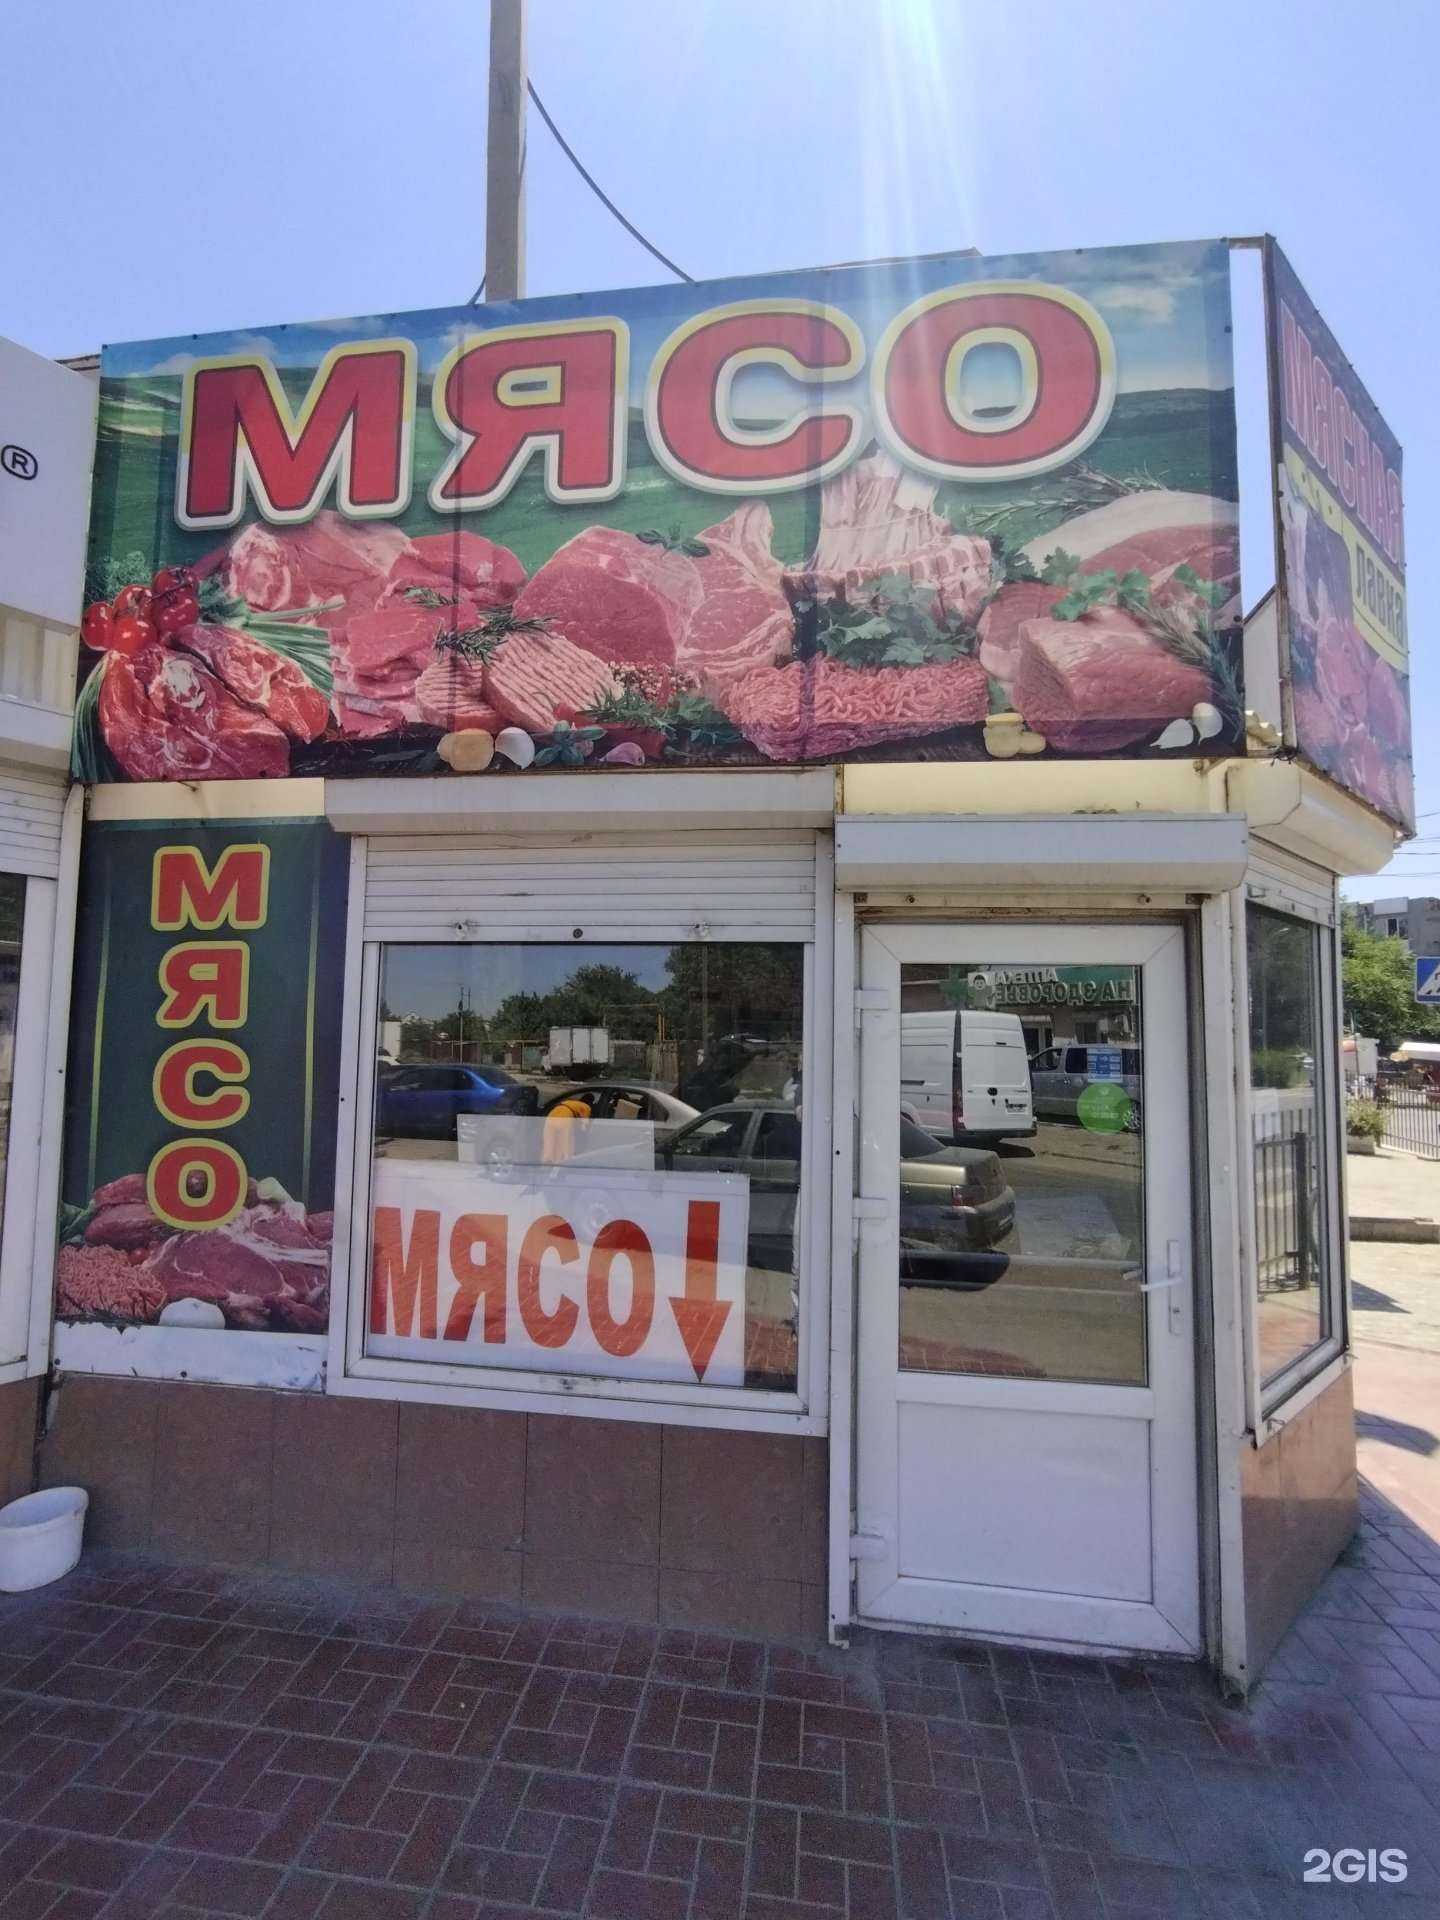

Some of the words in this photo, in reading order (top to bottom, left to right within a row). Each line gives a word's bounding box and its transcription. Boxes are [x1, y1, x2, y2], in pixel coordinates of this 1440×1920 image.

[176, 279, 1118, 531] МЯСО
[147, 844, 271, 1231] МЯСО
[370, 1206, 655, 1357] МЯСО
